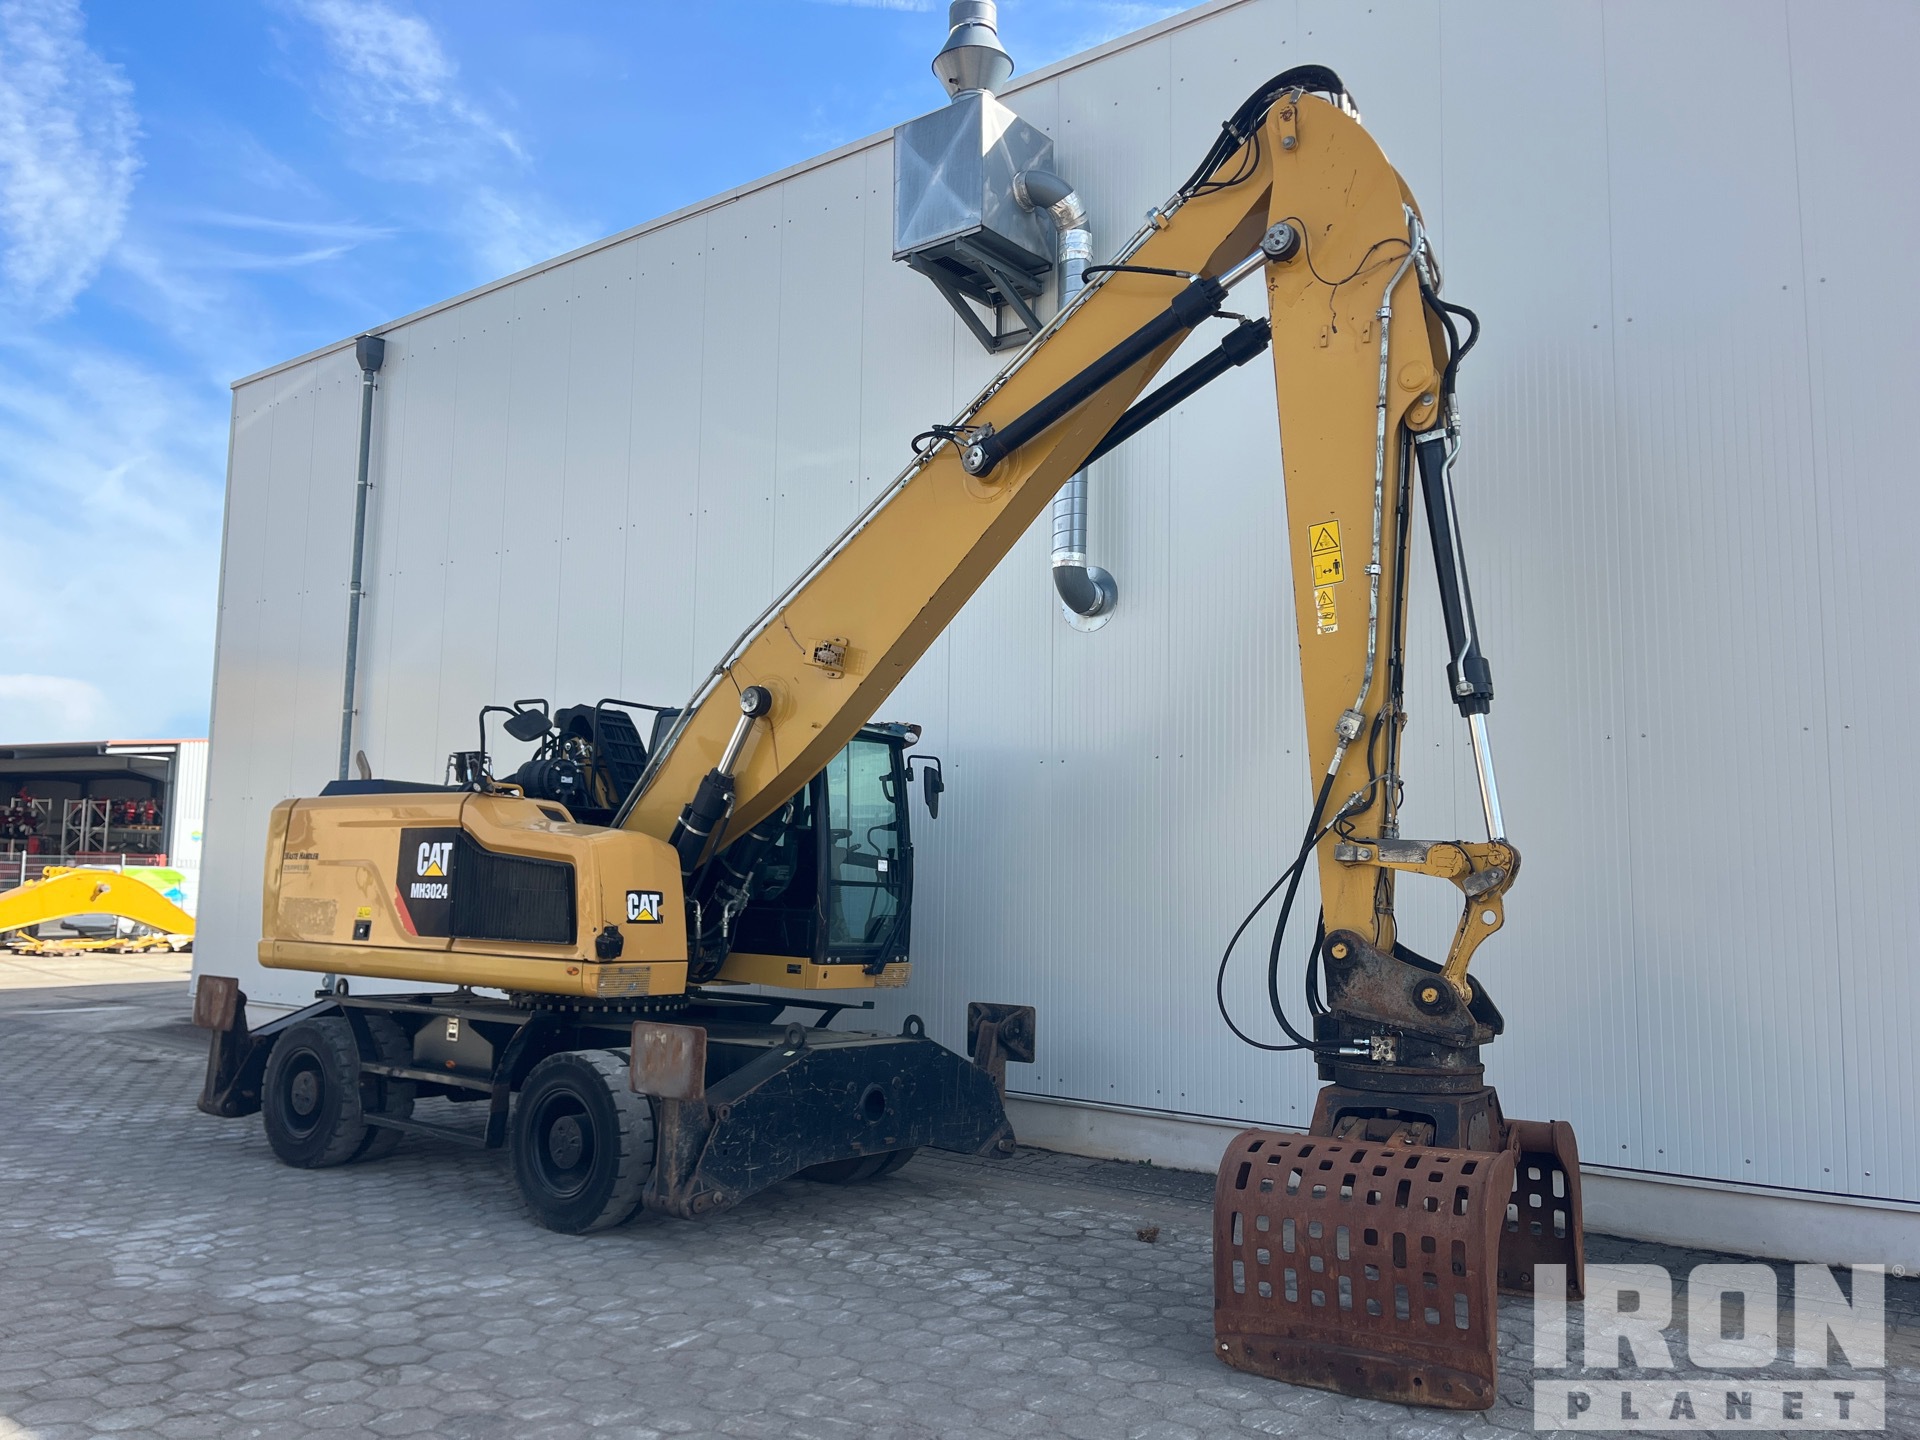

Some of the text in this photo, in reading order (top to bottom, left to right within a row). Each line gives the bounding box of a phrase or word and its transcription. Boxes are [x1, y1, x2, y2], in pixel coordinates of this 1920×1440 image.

[416, 841, 454, 877] CAT
[410, 882, 449, 900] MH3024
[627, 893, 660, 921] CAT
